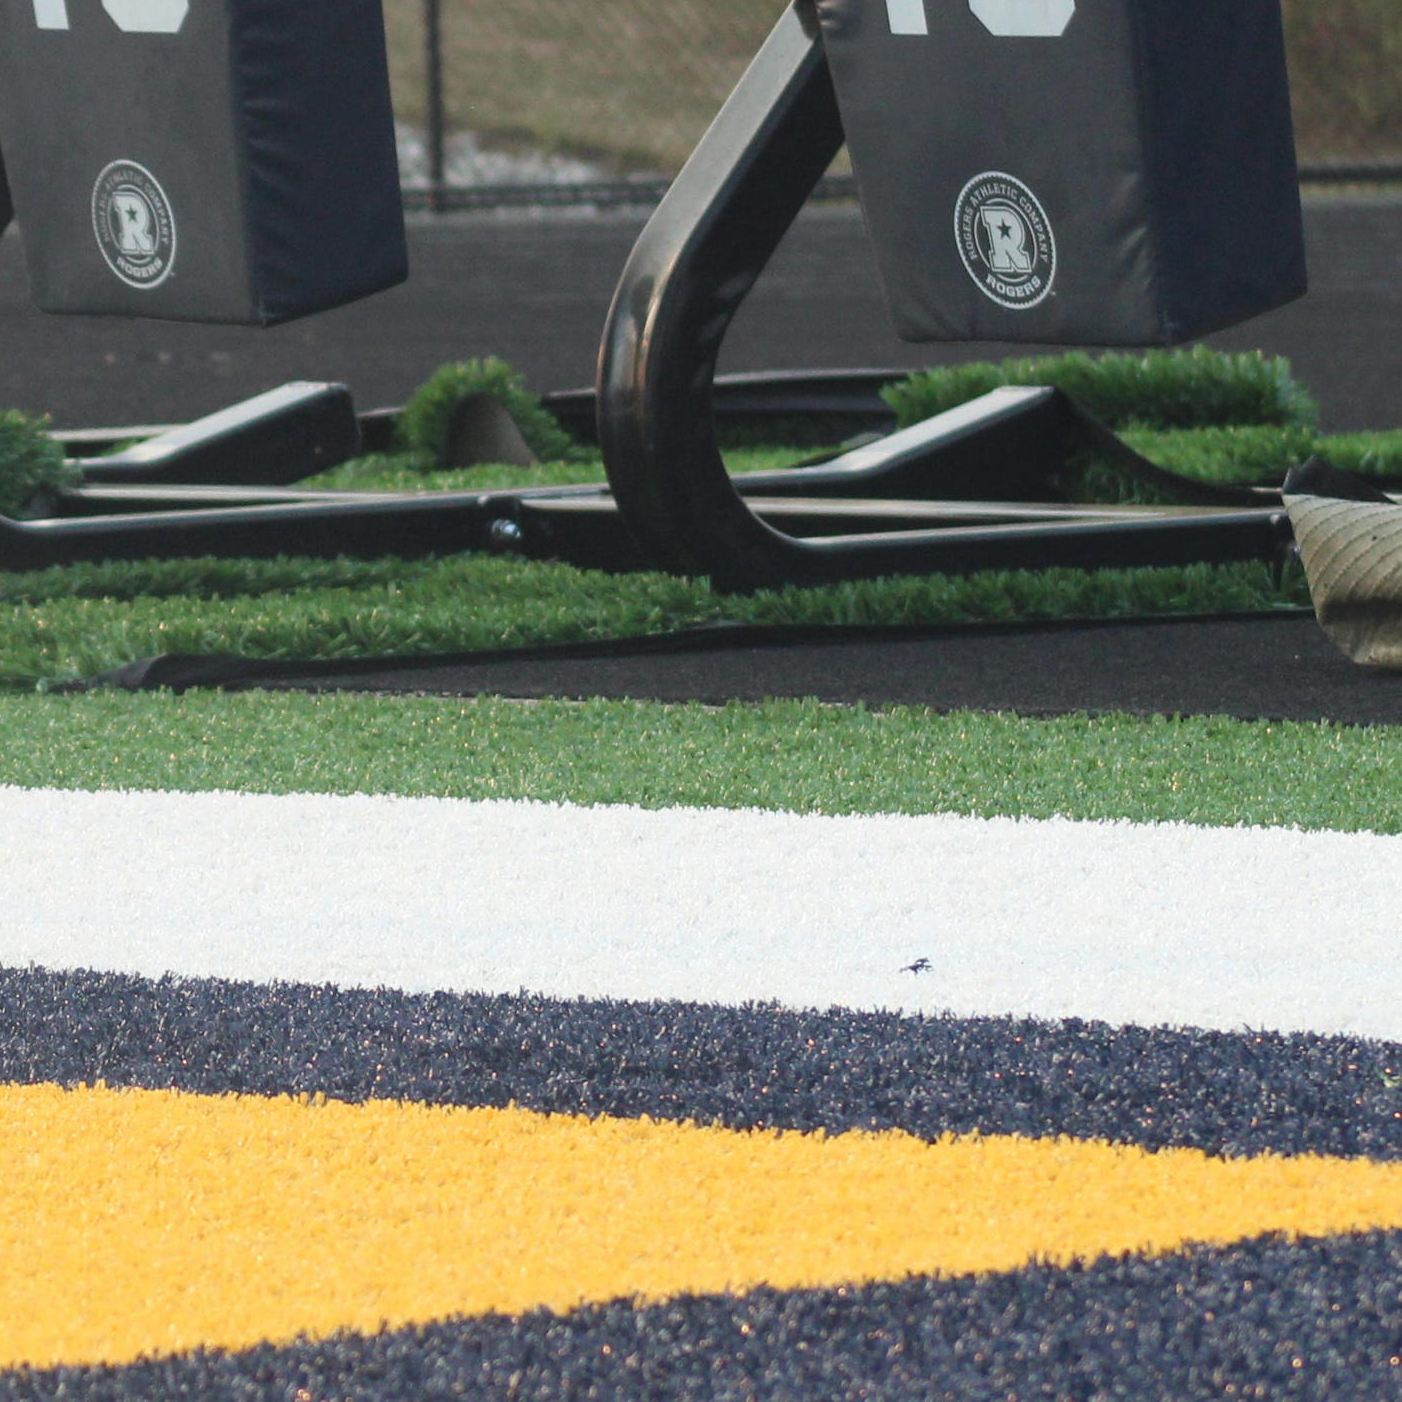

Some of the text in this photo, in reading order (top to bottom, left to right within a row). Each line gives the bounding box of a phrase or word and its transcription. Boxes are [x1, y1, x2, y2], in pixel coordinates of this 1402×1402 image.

[112, 191, 155, 254] R
[969, 182, 1018, 207] ATHLETIC
[1018, 196, 1049, 262] COMPANY
[980, 206, 1032, 273] R
[986, 273, 1041, 297] ROGERS
